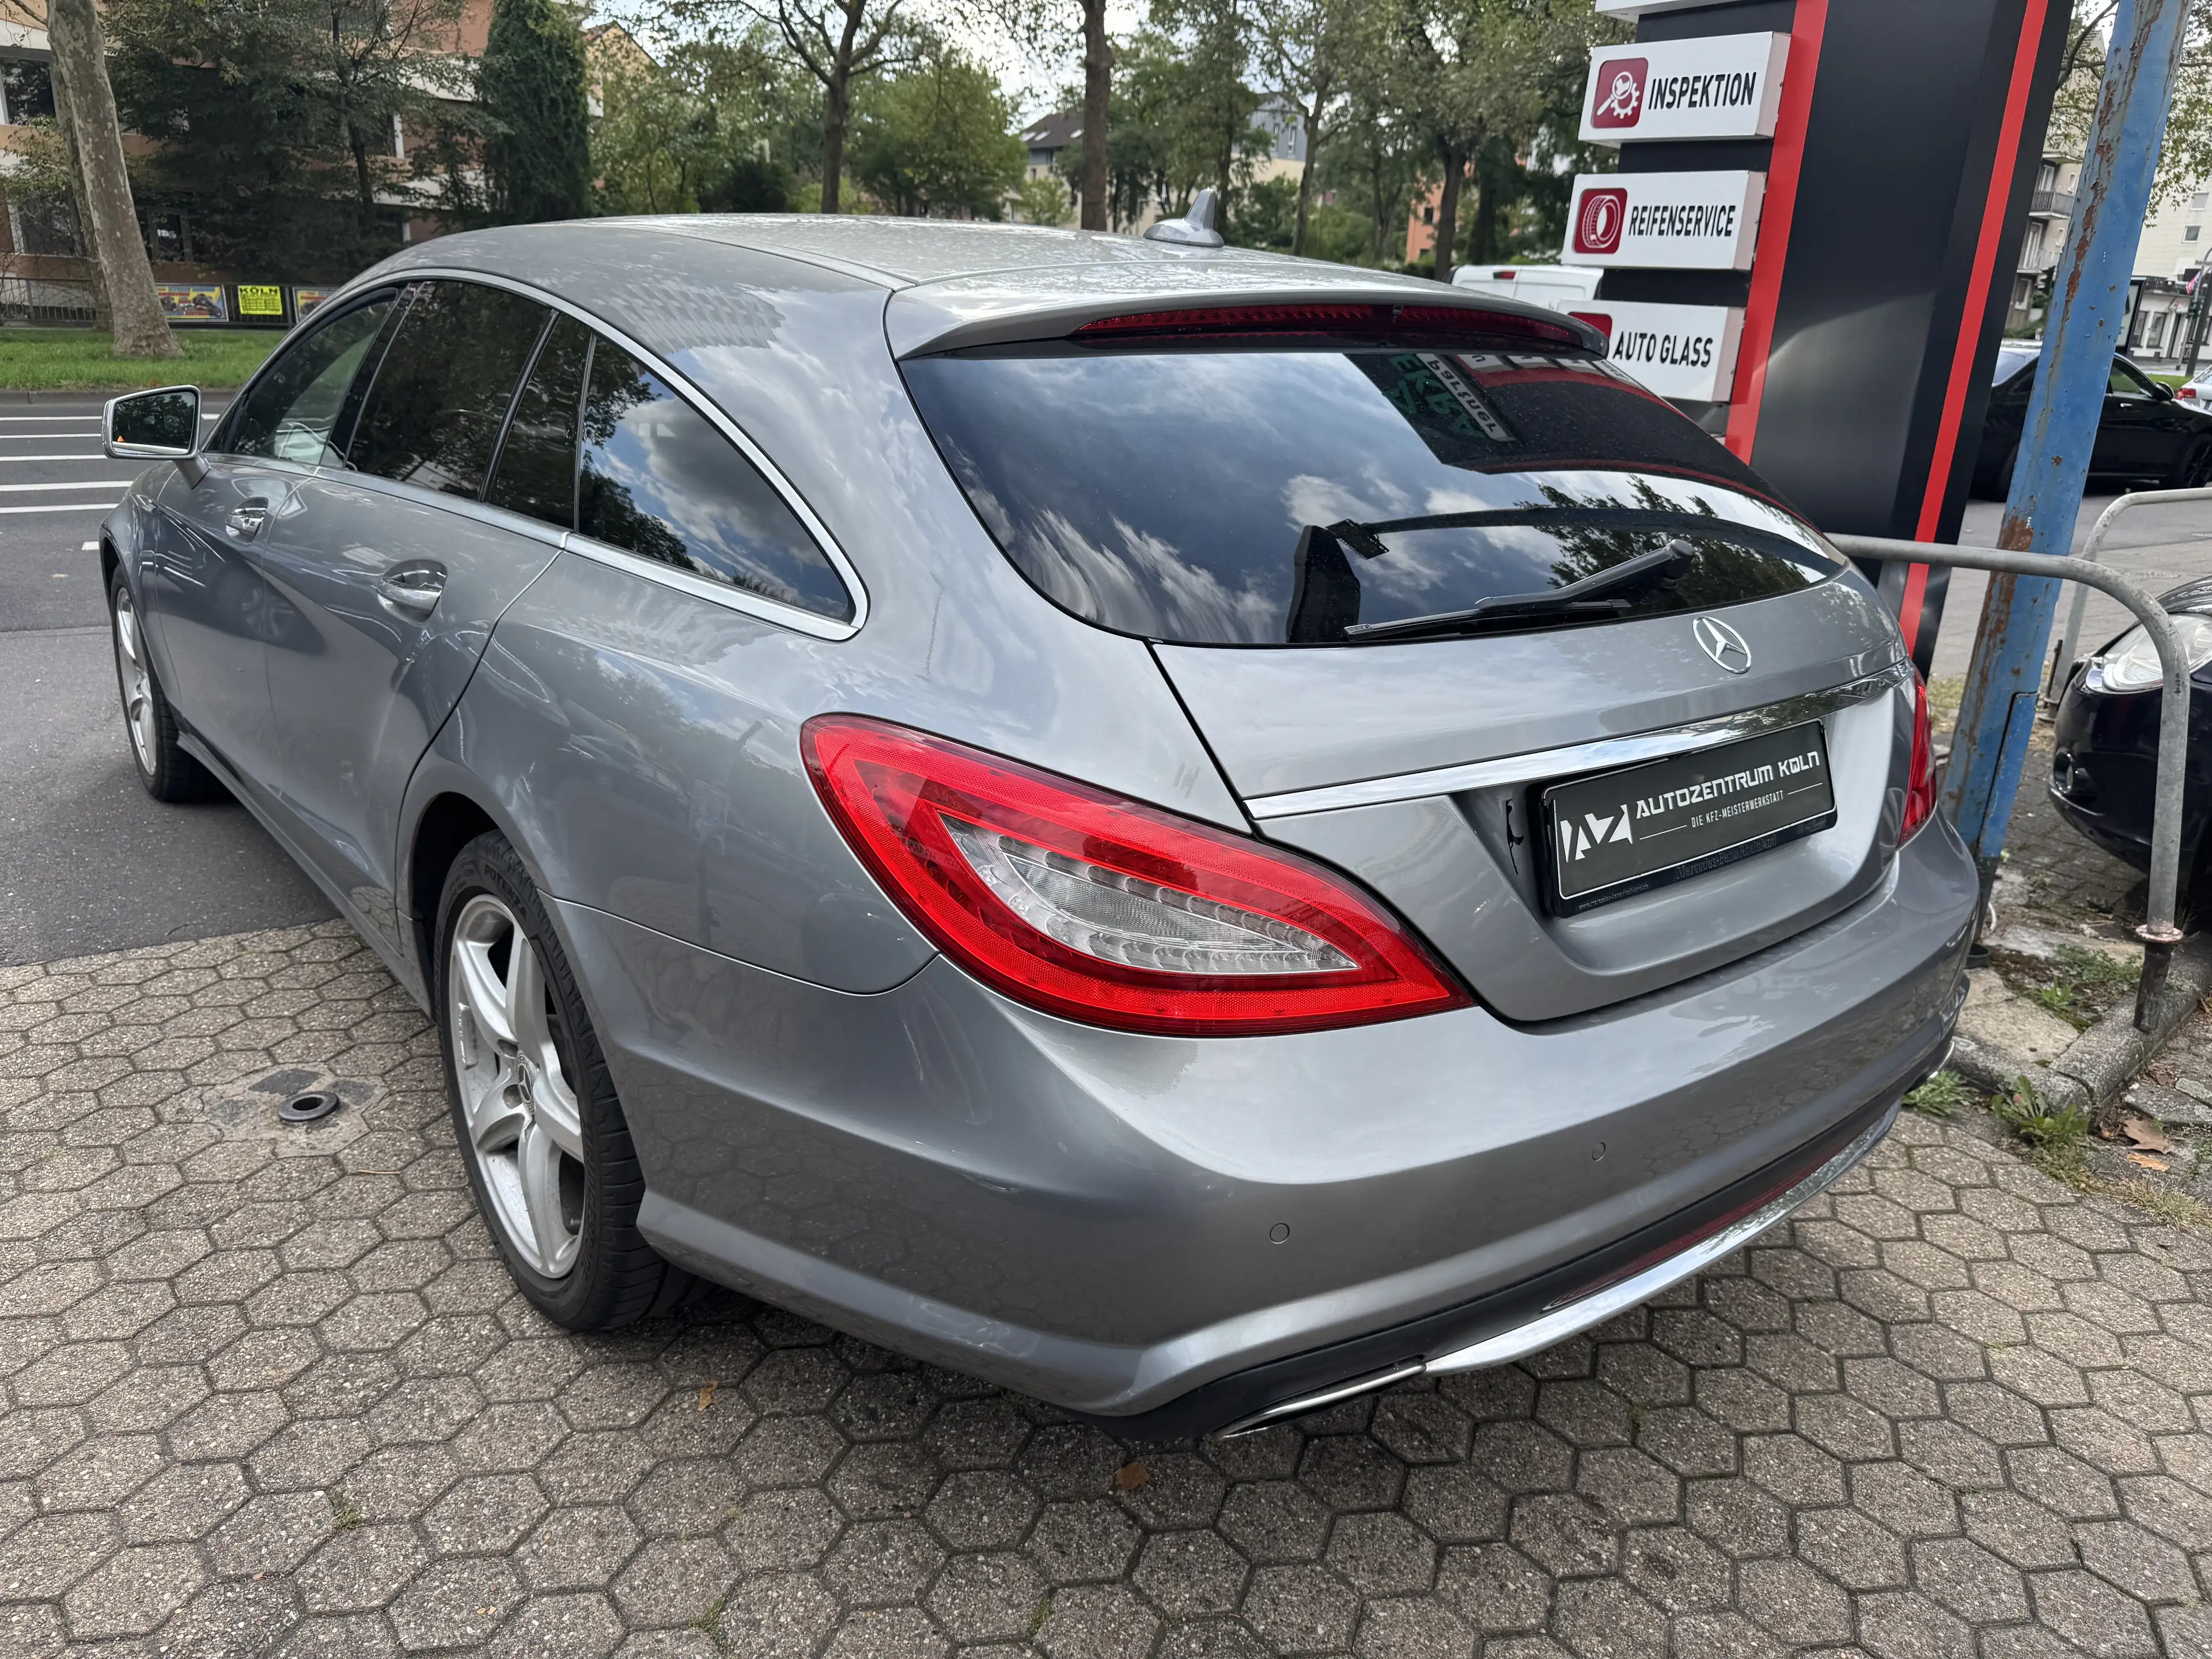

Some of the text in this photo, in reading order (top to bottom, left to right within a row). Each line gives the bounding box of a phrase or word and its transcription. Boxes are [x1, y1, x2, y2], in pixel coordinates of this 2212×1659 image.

[1648, 71, 1756, 110] INSPEKTION
[1628, 204, 1736, 237] REIFENSERVICE
[239, 286, 278, 295] KÖLN
[1613, 331, 1714, 368] AUTO GLASS
[1635, 764, 1774, 819] AUTOZENTRUM
[1691, 790, 1784, 828] DIE KFZ-MEISTERWERKSTATT
[1675, 852, 1736, 880] Mercedes-Ben
[484, 863, 528, 923] POTENZA
